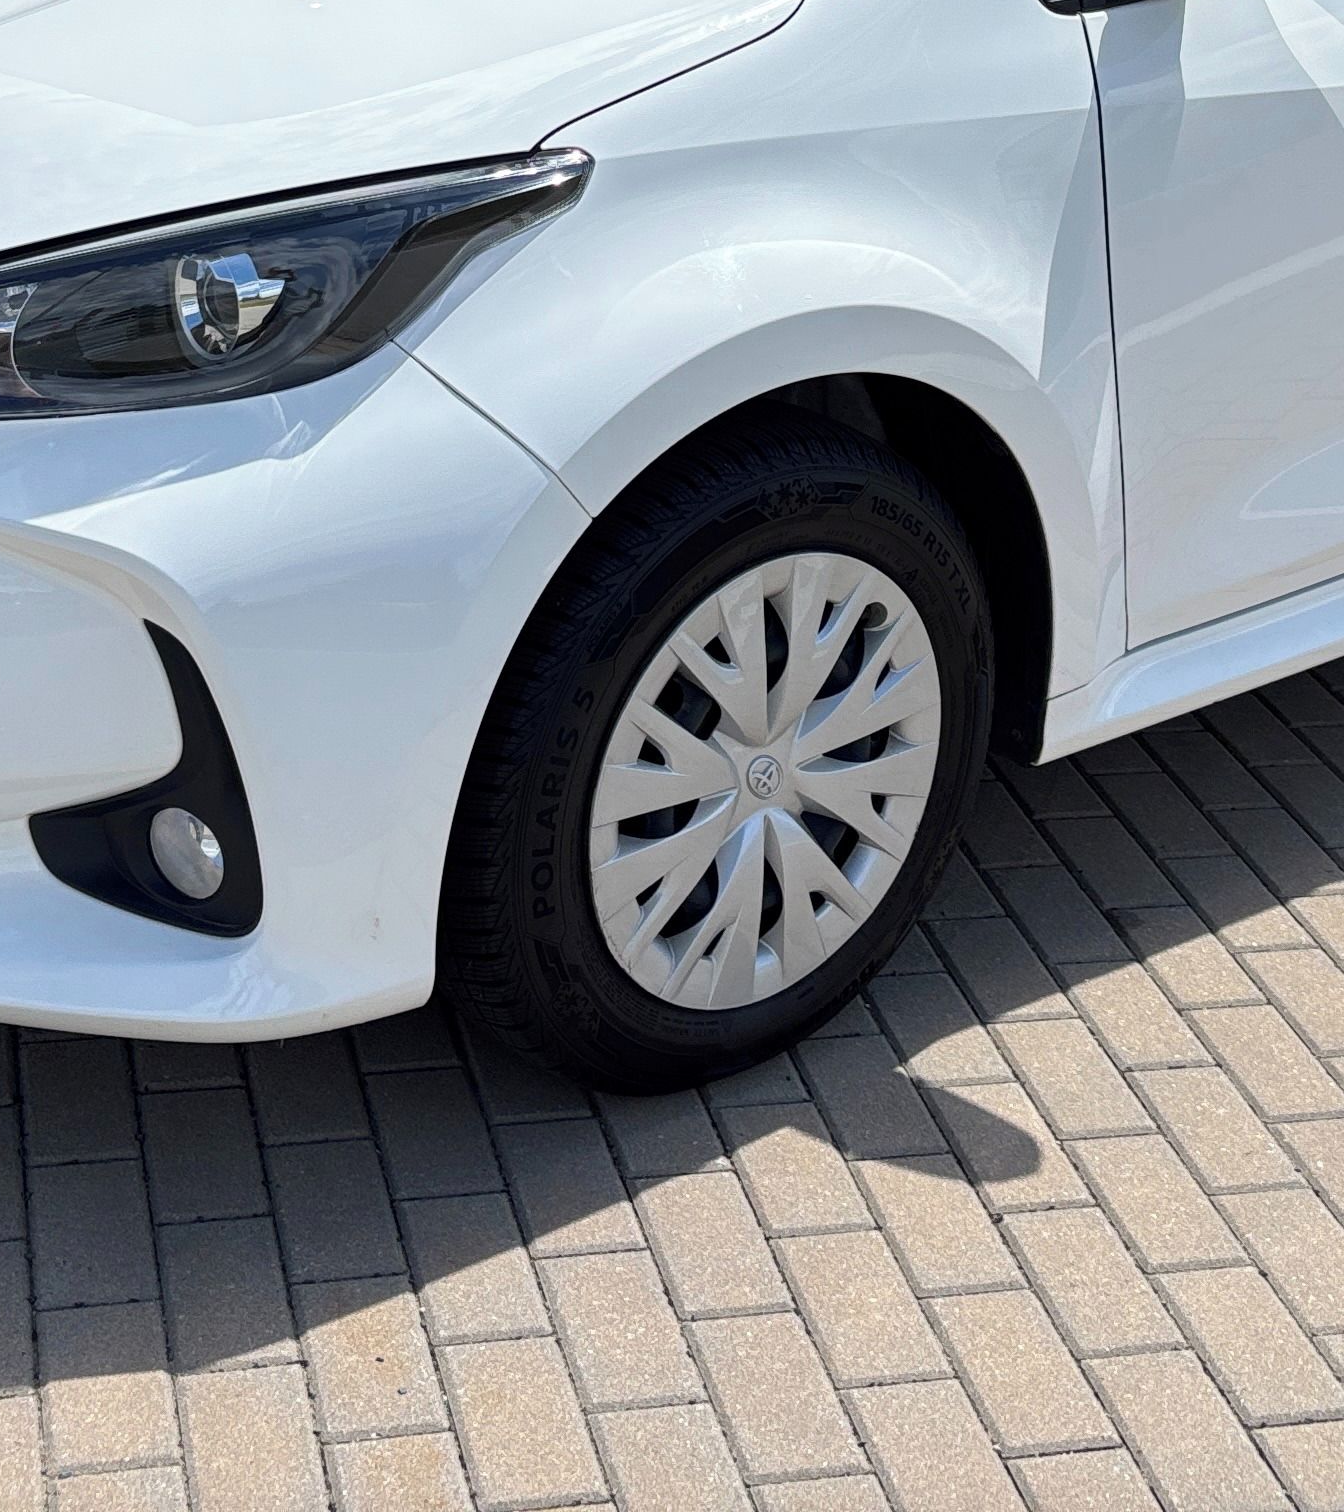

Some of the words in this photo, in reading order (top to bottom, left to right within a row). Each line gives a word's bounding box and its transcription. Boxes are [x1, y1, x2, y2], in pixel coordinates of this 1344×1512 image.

[871, 496, 923, 537] 185/65
[923, 530, 951, 567] R15
[956, 580, 971, 615] XL
[529, 726, 579, 919] POLARIS
[572, 688, 594, 714] 5
